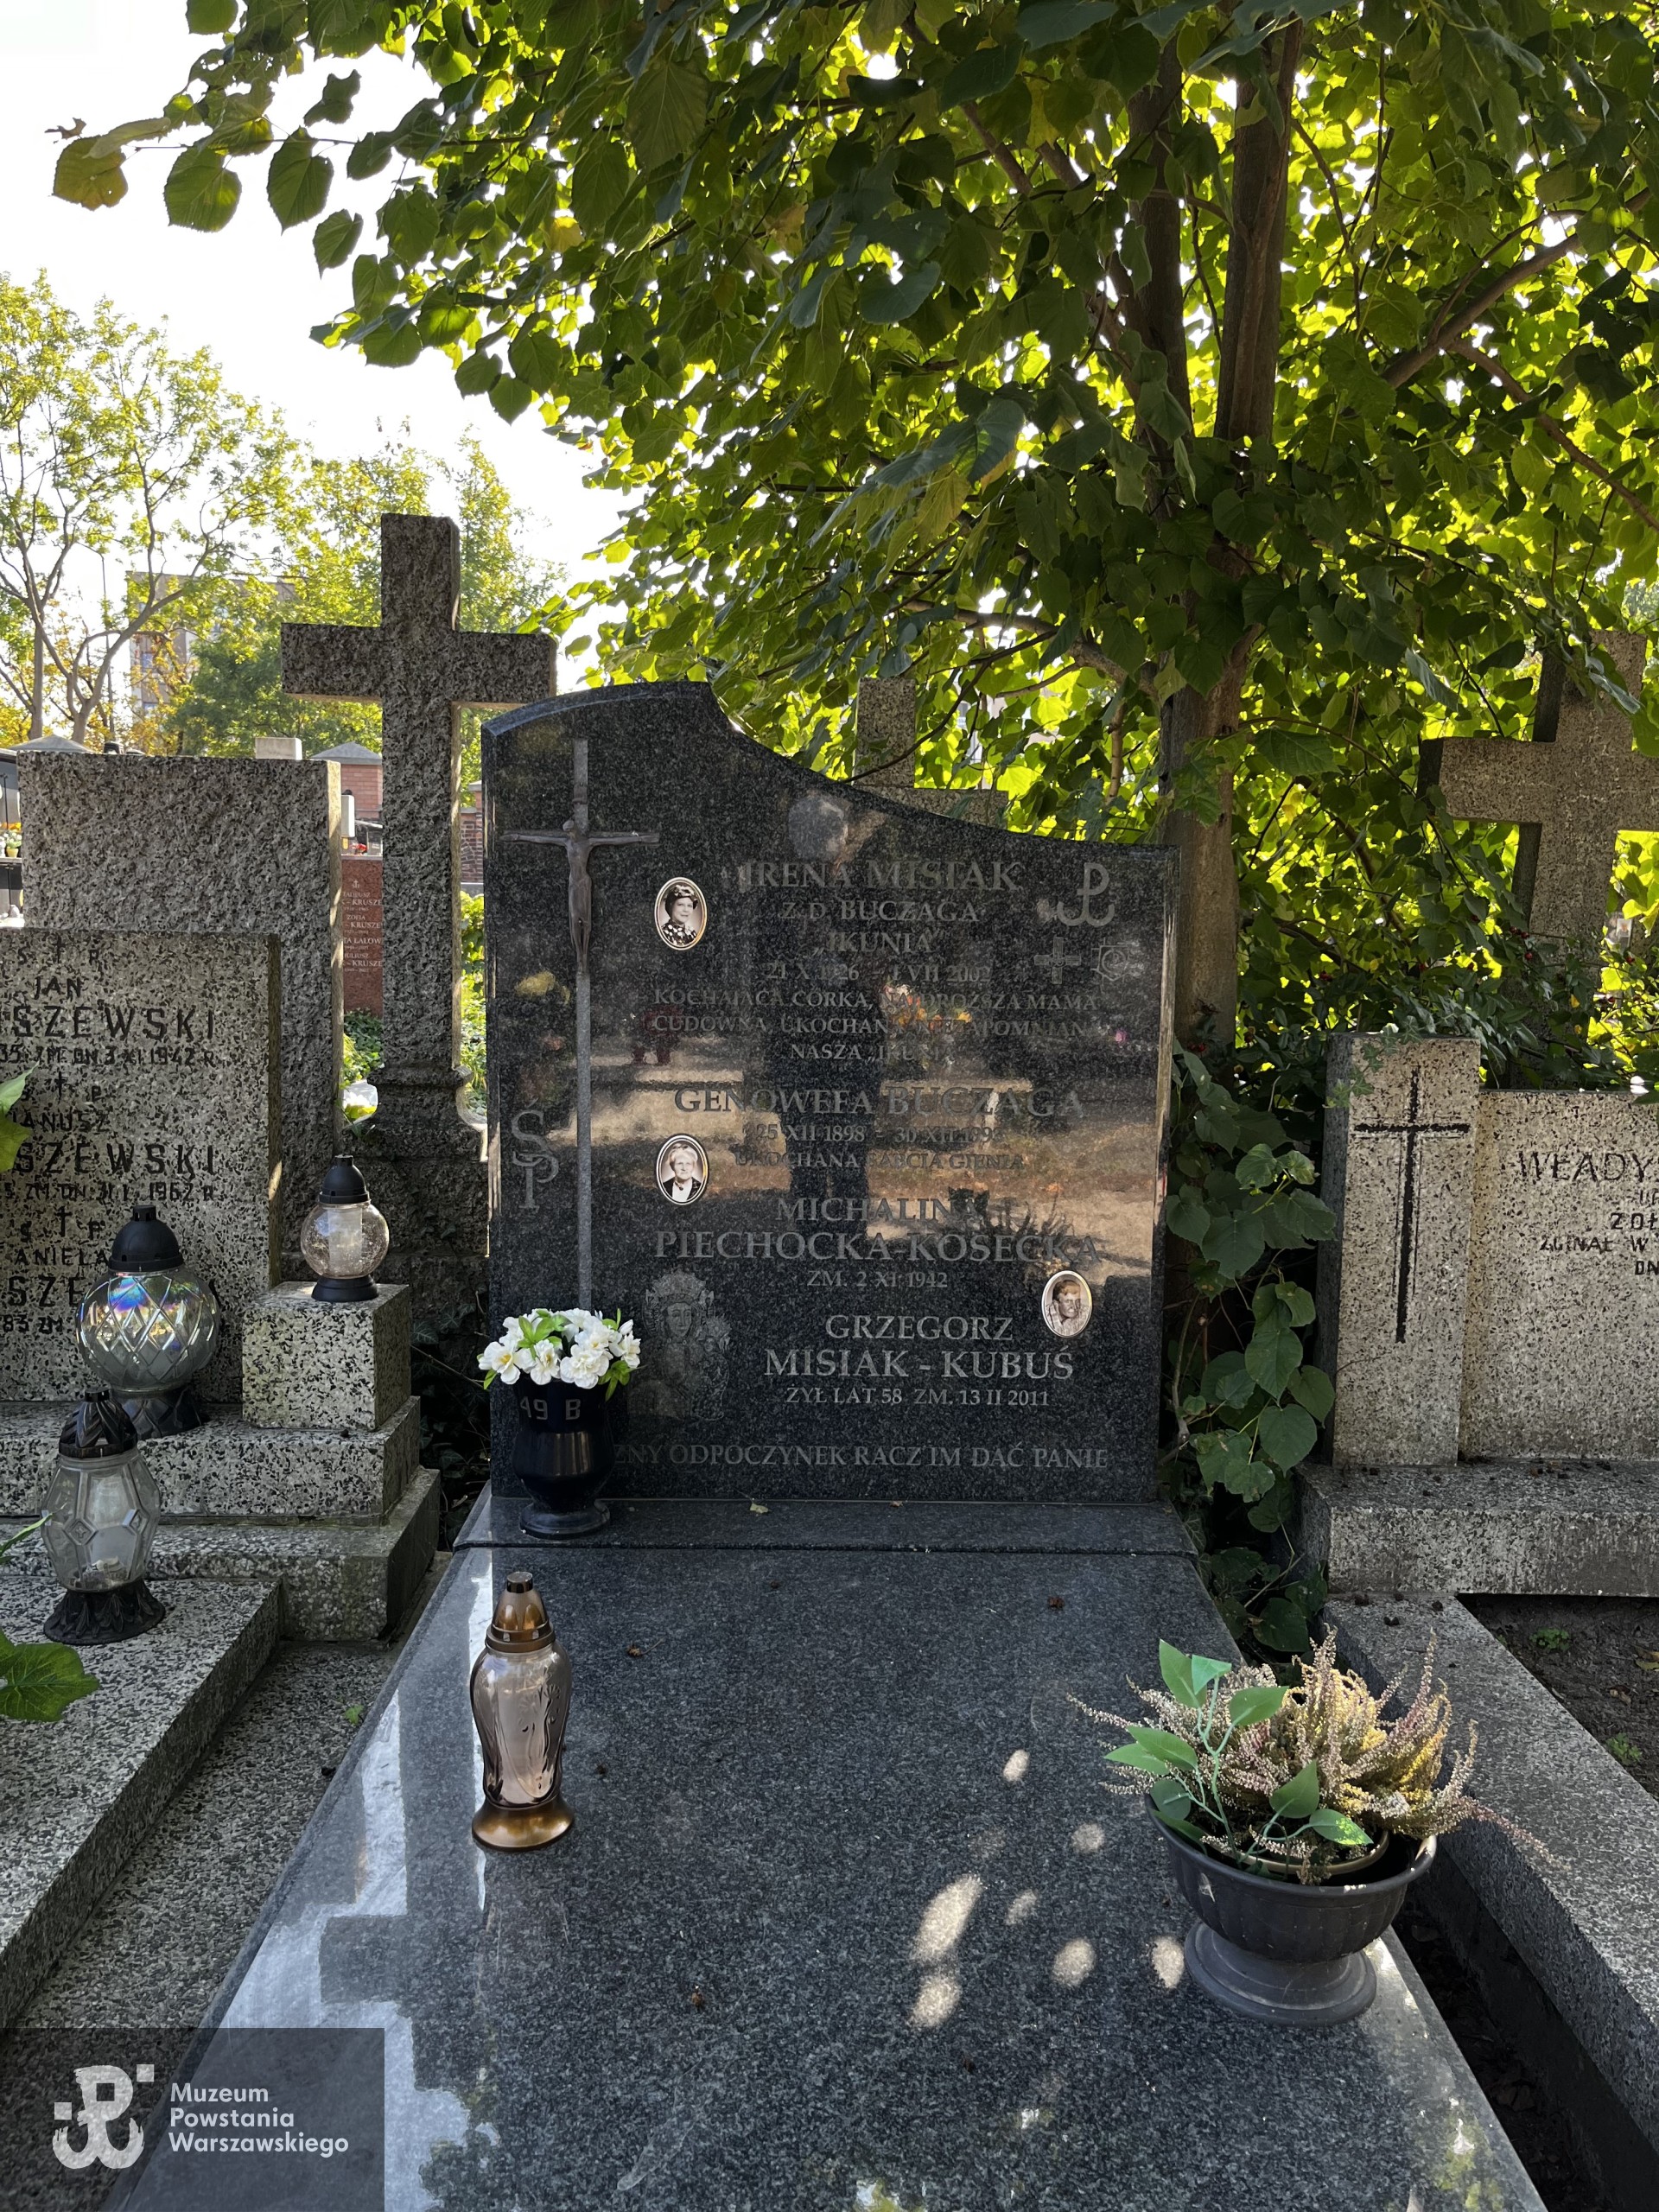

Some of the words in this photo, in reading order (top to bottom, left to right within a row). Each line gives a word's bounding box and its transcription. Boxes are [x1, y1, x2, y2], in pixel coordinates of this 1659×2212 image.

[745, 860, 853, 889] IRENA
[867, 860, 1025, 891] MISIAK
[840, 899, 980, 922] BUCZAGA
[796, 963, 810, 979] X
[819, 963, 861, 981] 126
[34, 976, 83, 1001] JAN
[1026, 993, 1098, 1010] MAMA
[13, 1004, 214, 1040] SZEWSKI
[790, 1043, 863, 1061] NASZA
[674, 1086, 875, 1116] GENOWEFA
[885, 1086, 1085, 1118] BUCZAGA
[785, 1124, 817, 1141] XII
[823, 1125, 866, 1142] 1898
[893, 1126, 917, 1143] 30
[16, 1141, 216, 1179] SZEWSKI
[735, 1149, 860, 1167] UKOCHANA
[777, 1197, 979, 1223] MICHALINA
[655, 1230, 1103, 1264] PIECHOCKA-KOSECKA
[1630, 1235, 1649, 1253] W
[14, 1247, 108, 1267] ANIELA
[807, 1269, 849, 1288] ZM.
[857, 1270, 868, 1288] 2
[906, 1270, 949, 1289] 1942
[824, 1314, 1014, 1342] GRZEGORZ
[763, 1348, 910, 1378] MISIAK
[940, 1344, 1075, 1381] KUBUŚ
[785, 1382, 828, 1404] ŻYŁ
[832, 1387, 875, 1405] LAT
[880, 1388, 903, 1405] 58
[913, 1388, 954, 1406] ZM.
[959, 1389, 981, 1406] 13
[986, 1389, 1002, 1406] II
[1007, 1389, 1050, 1407] 2011
[519, 1395, 549, 1421] 49
[565, 1398, 582, 1421] B
[669, 1444, 848, 1467] ODPOCZYNEK
[854, 1445, 922, 1467] RACZ
[929, 1446, 961, 1467] IM
[971, 1440, 1025, 1468] DAĆ
[1033, 1447, 1109, 1469] PANIE
